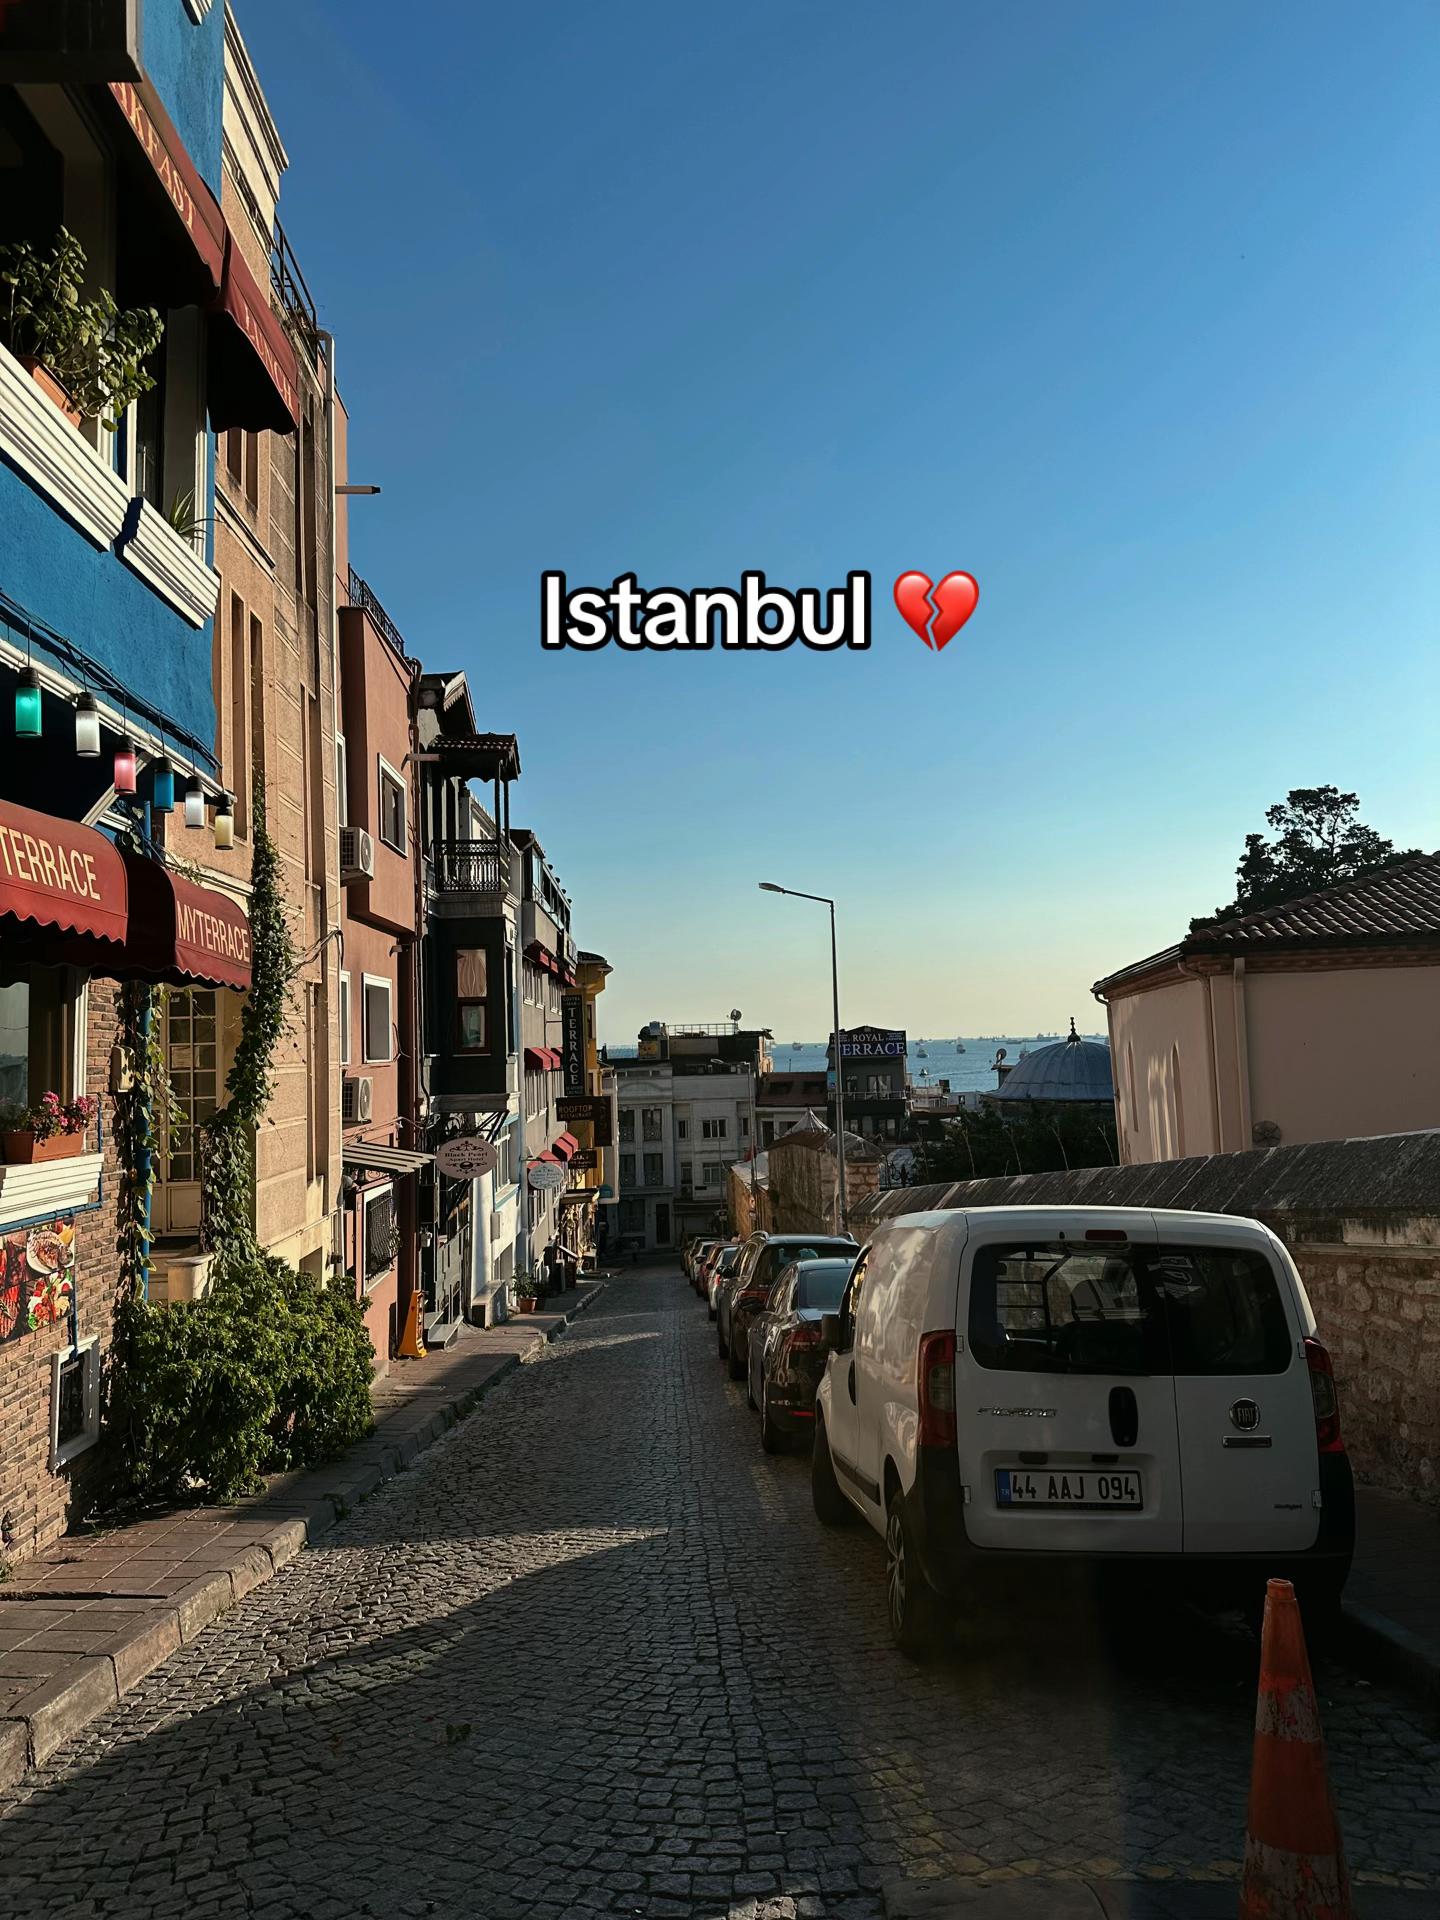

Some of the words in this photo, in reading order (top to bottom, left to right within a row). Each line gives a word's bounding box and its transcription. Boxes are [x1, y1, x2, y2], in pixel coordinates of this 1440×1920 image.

[243, 304, 294, 412] LUNCH
[0, 825, 101, 900] TERRACE
[176, 900, 250, 962] MYTERRACE
[568, 1007, 580, 1085] TERRACE
[841, 1042, 906, 1056] ERRACE
[852, 1033, 884, 1042] ROYAL
[558, 1105, 593, 1113] ROOFTOP
[1237, 1407, 1255, 1424] FIAT
[1012, 1475, 1037, 1499] 44
[1048, 1476, 1085, 1500] AAJ
[1098, 1477, 1136, 1501] 094
